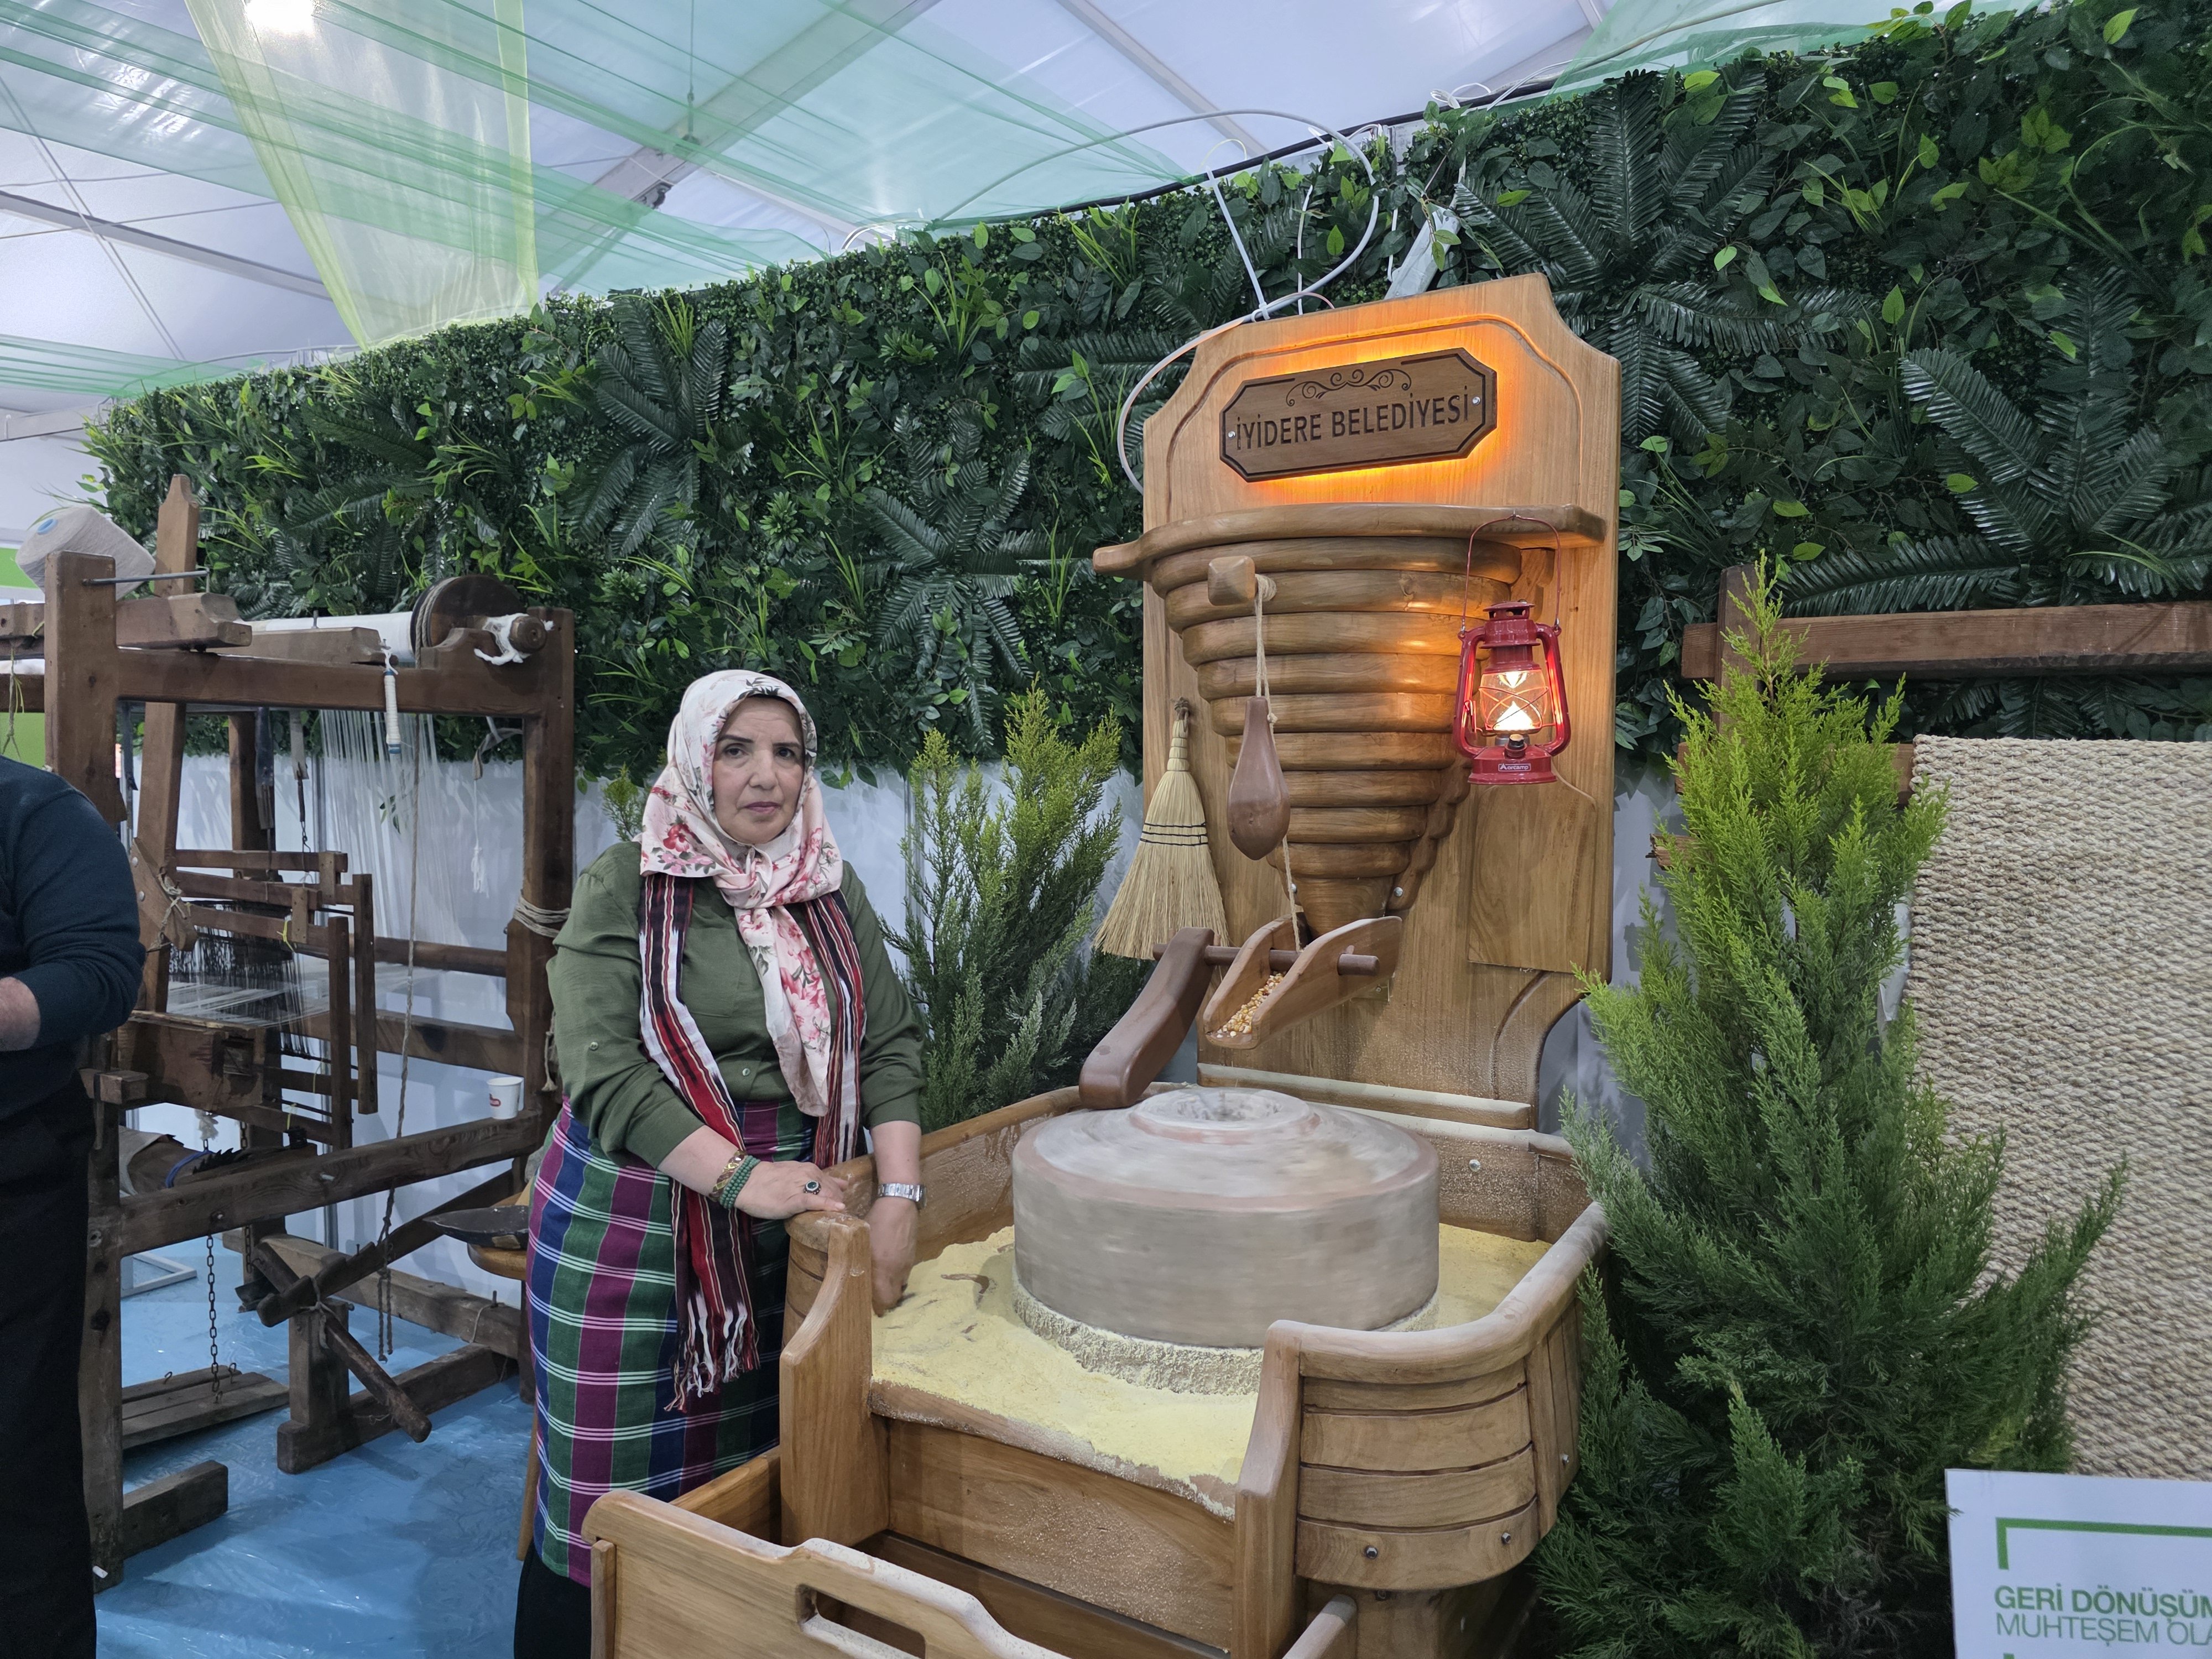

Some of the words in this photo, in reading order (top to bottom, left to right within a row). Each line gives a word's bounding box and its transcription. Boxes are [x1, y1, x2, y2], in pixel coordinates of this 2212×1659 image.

[1236, 414, 1322, 451] İYİDERE
[1332, 385, 1469, 438] BELEDİYESİ
[1994, 1583, 2063, 1611] GERİ
[1996, 1612, 2158, 1647] MUHTEŞEM
